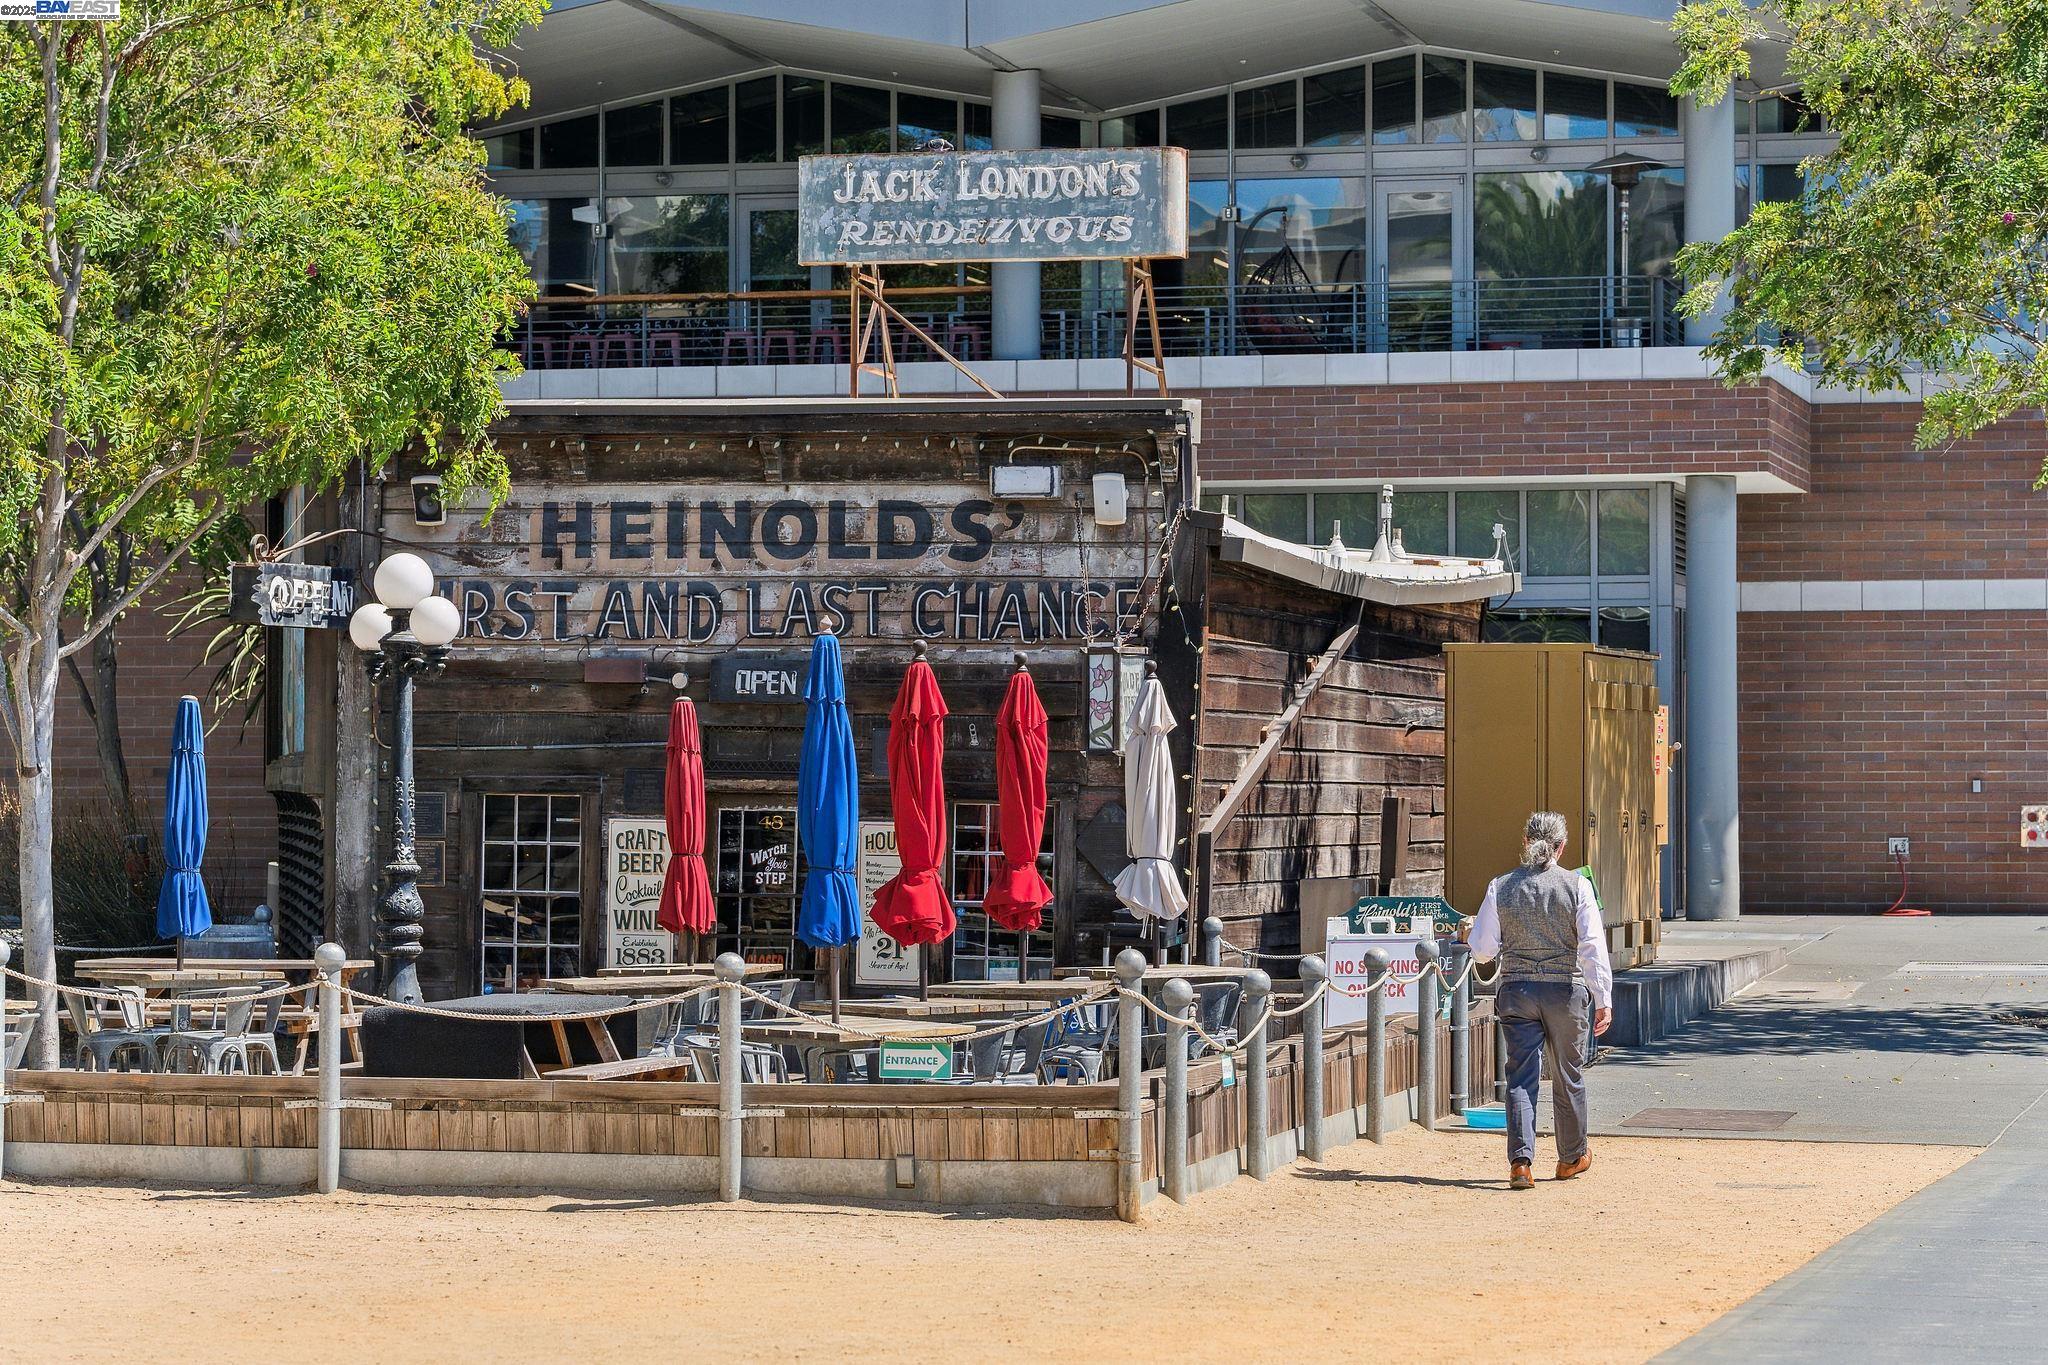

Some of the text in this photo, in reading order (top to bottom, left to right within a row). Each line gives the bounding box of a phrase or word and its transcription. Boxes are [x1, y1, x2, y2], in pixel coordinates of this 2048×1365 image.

[833, 160, 1144, 203] JACK LONDON'S
[838, 215, 1136, 247] RENDEZVOUS
[541, 500, 1026, 563] HEINOLDS'
[595, 579, 723, 643] AND
[742, 580, 889, 638] LAST
[910, 580, 1139, 644] CHANCE
[735, 669, 798, 695] OPEN
[758, 815, 784, 830] 48
[615, 828, 667, 851] CRAFT
[865, 831, 896, 851] HOU
[618, 852, 664, 874] BEER
[751, 844, 787, 866] WATCH
[765, 856, 789, 872] Your
[615, 875, 662, 904] Cocktail
[755, 872, 787, 885] STEP
[615, 947, 665, 966] 1883
[1335, 960, 1354, 975] NO
[885, 1056, 938, 1066] ENTRANCE
